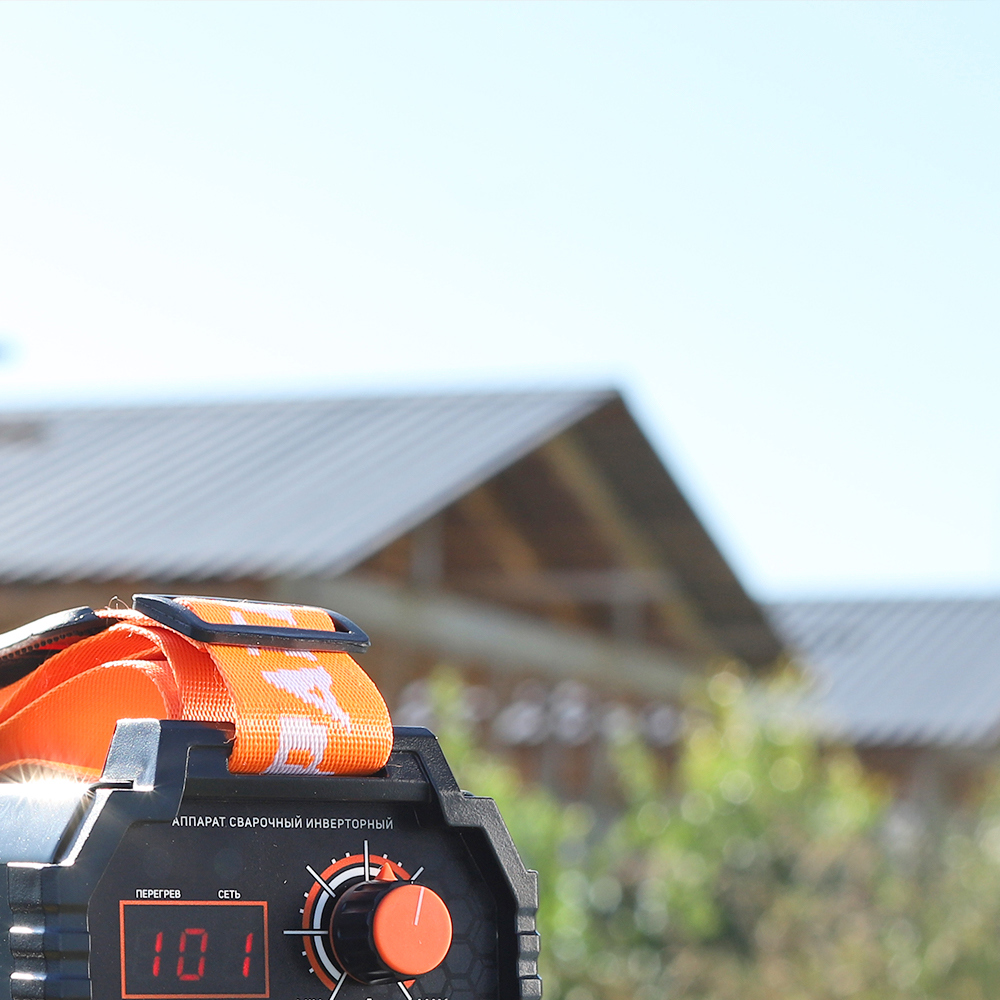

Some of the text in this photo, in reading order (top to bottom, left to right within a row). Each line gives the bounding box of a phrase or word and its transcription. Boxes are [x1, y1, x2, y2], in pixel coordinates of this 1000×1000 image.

[171, 815, 394, 830] АППАРАТ СВАРОЧНЫЙ ИНВЕРТОРНЫЙ
[135, 889, 182, 899] ПЕРЕГРЕВ
[217, 889, 242, 899] СЕТЬ
[152, 928, 254, 981] 101
